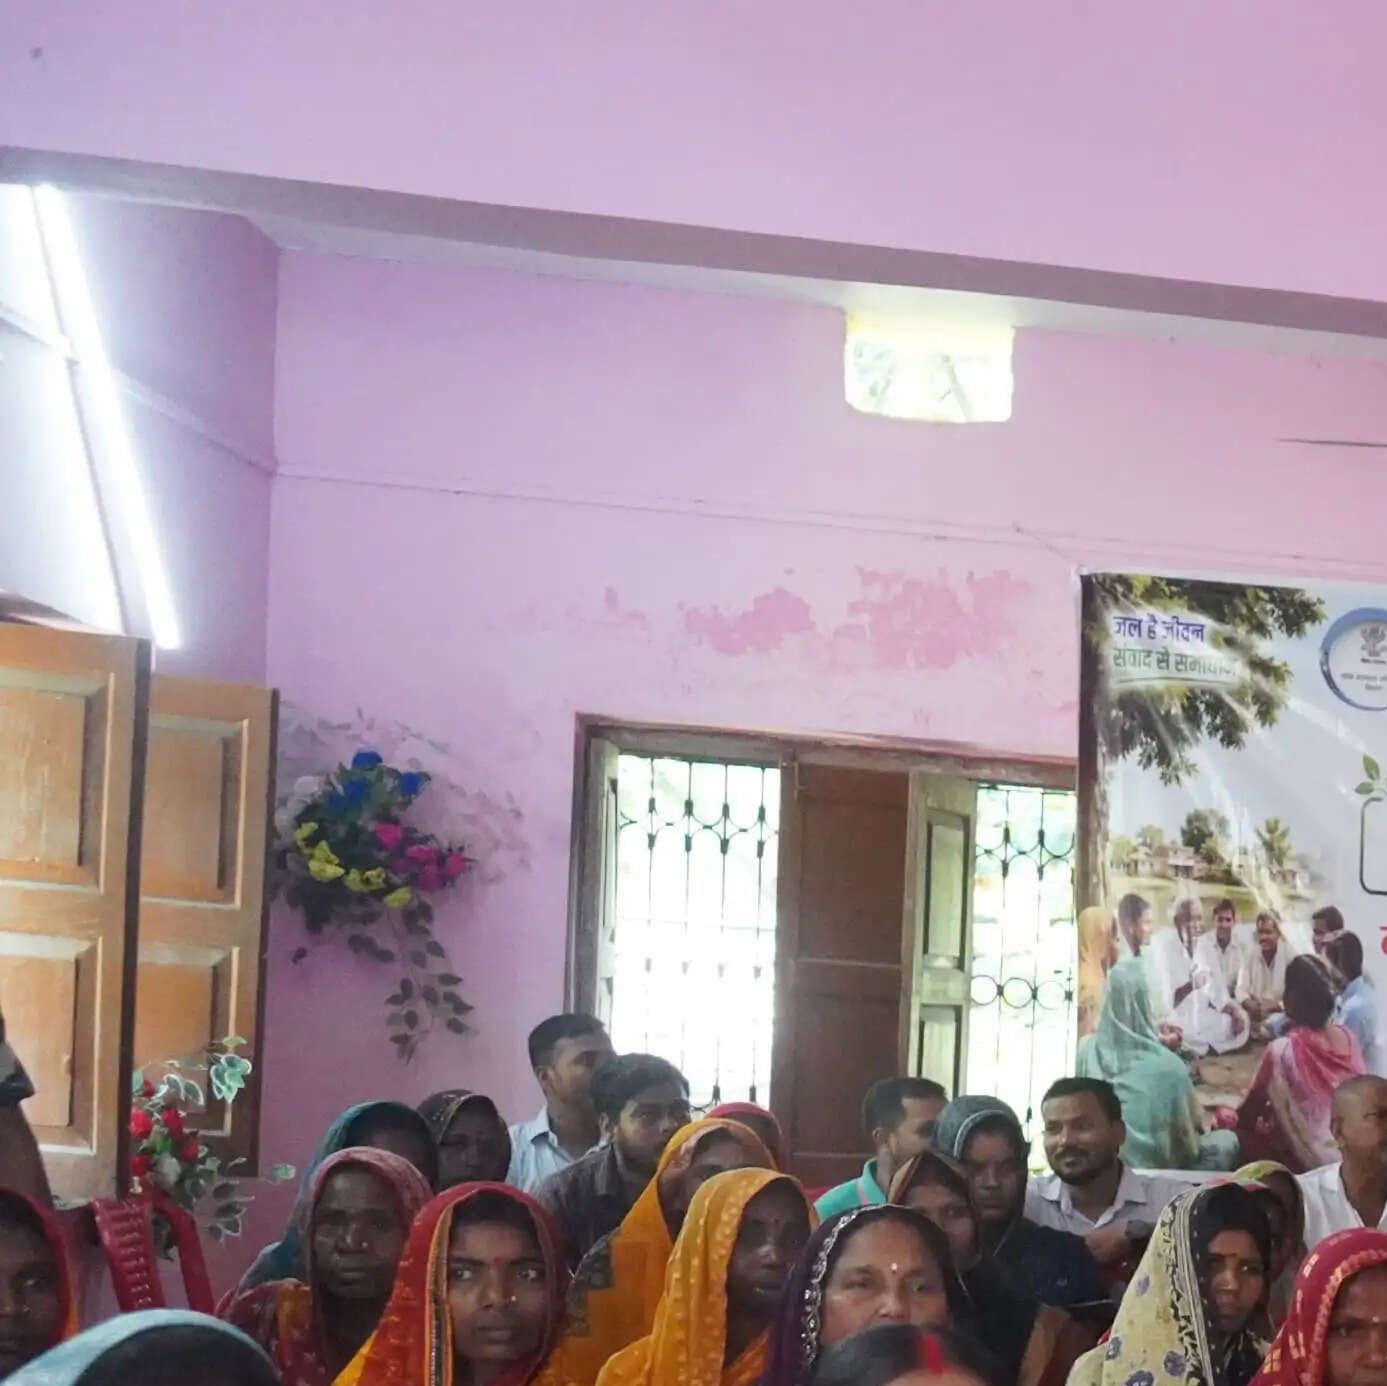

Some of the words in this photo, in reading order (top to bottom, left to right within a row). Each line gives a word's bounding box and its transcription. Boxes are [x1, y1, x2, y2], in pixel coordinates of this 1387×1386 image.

[1113, 616, 1142, 638] जल
[1144, 612, 1157, 640] है
[1161, 615, 1205, 642] जीवन
[1154, 646, 1170, 671] से
